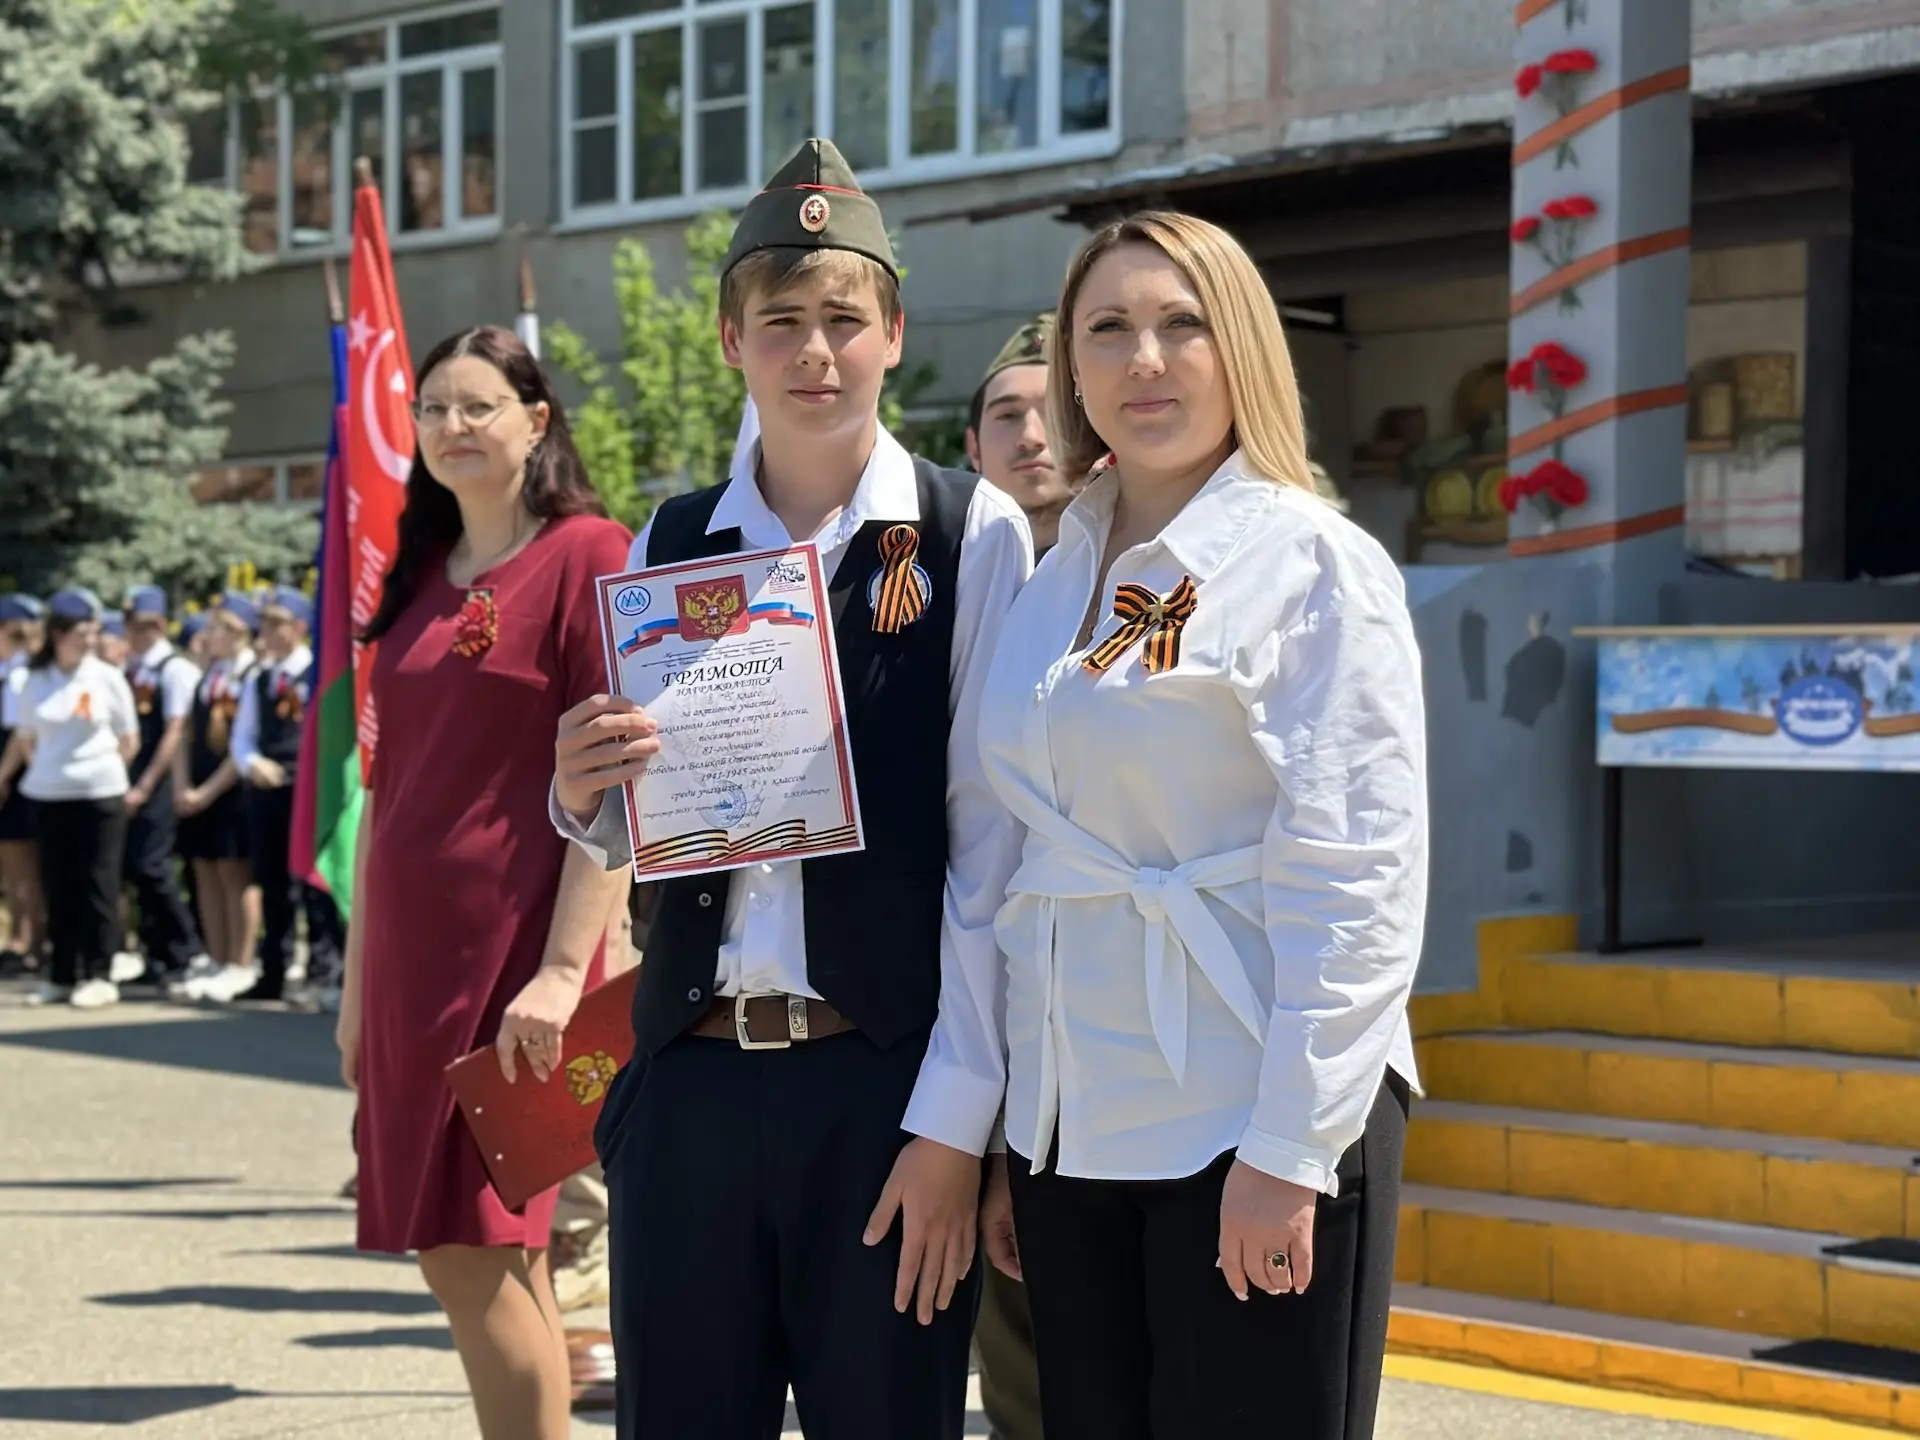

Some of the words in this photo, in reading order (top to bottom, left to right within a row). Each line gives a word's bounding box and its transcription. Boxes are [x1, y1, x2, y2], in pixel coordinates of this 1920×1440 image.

[662, 656, 784, 687] ГРАМОТА
[676, 676, 772, 697] НАГРАЖДАЕТСЯ
[693, 705, 737, 717] активное
[738, 699, 777, 713] участие
[705, 716, 741, 727] смотре
[743, 711, 772, 724] строя
[698, 728, 760, 742] посвященном
[702, 740, 764, 755] 81-годовщине
[643, 763, 678, 776] Победы
[687, 758, 727, 772] Великой
[728, 747, 800, 764] Отечественной
[802, 744, 828, 755] войне
[701, 767, 748, 782] 1941-1945
[772, 774, 807, 786] классов
